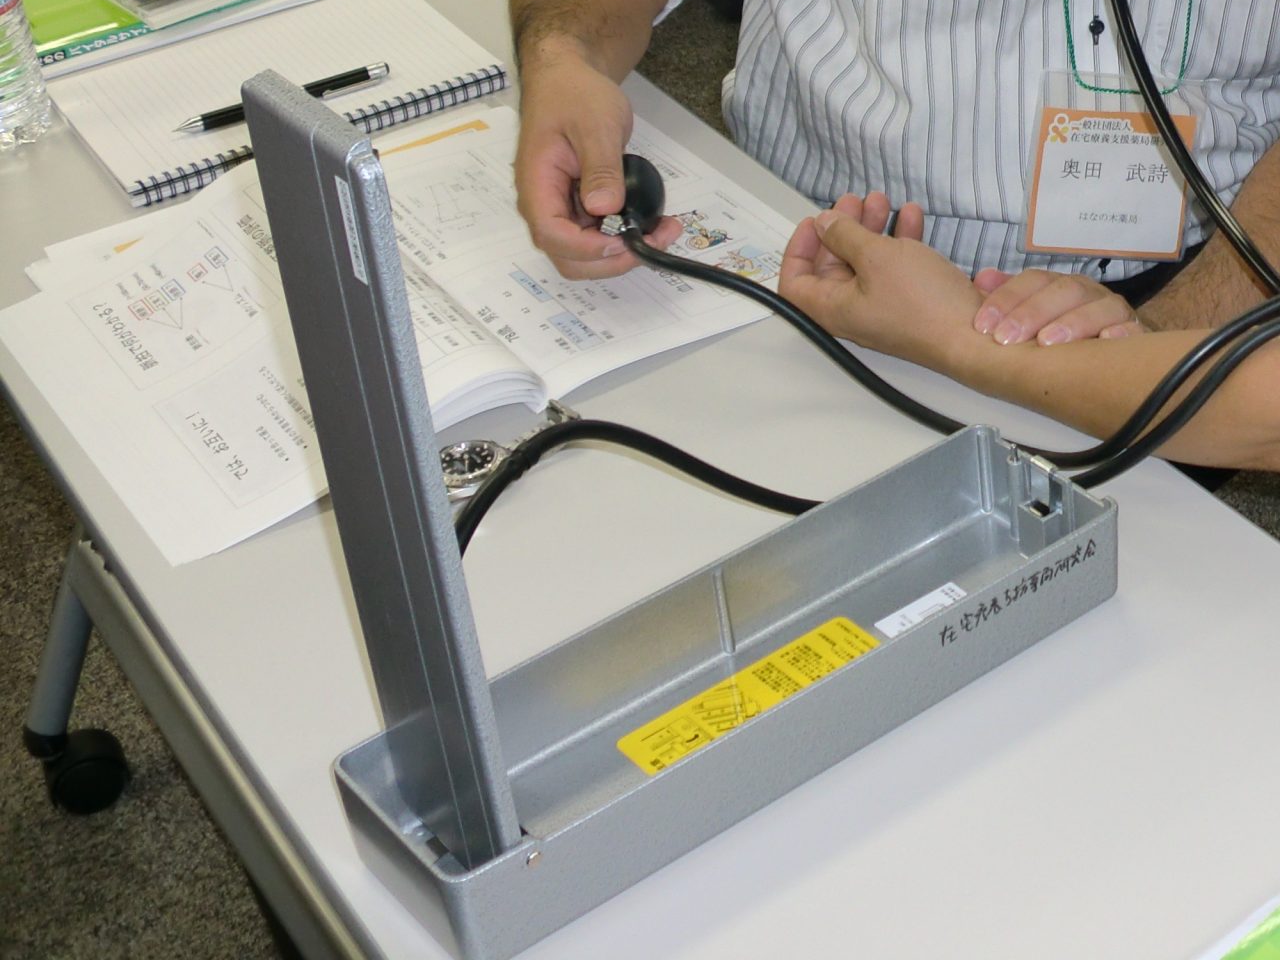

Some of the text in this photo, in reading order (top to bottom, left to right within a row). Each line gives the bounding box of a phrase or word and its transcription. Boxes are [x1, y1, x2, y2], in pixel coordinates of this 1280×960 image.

[1071, 120, 1131, 132] 一般社団法人
[1070, 132, 1166, 146] 在宅療養支援薬局研
[1060, 158, 1169, 184] 奥田 武詩
[1078, 212, 1139, 225] はなの木薬局
